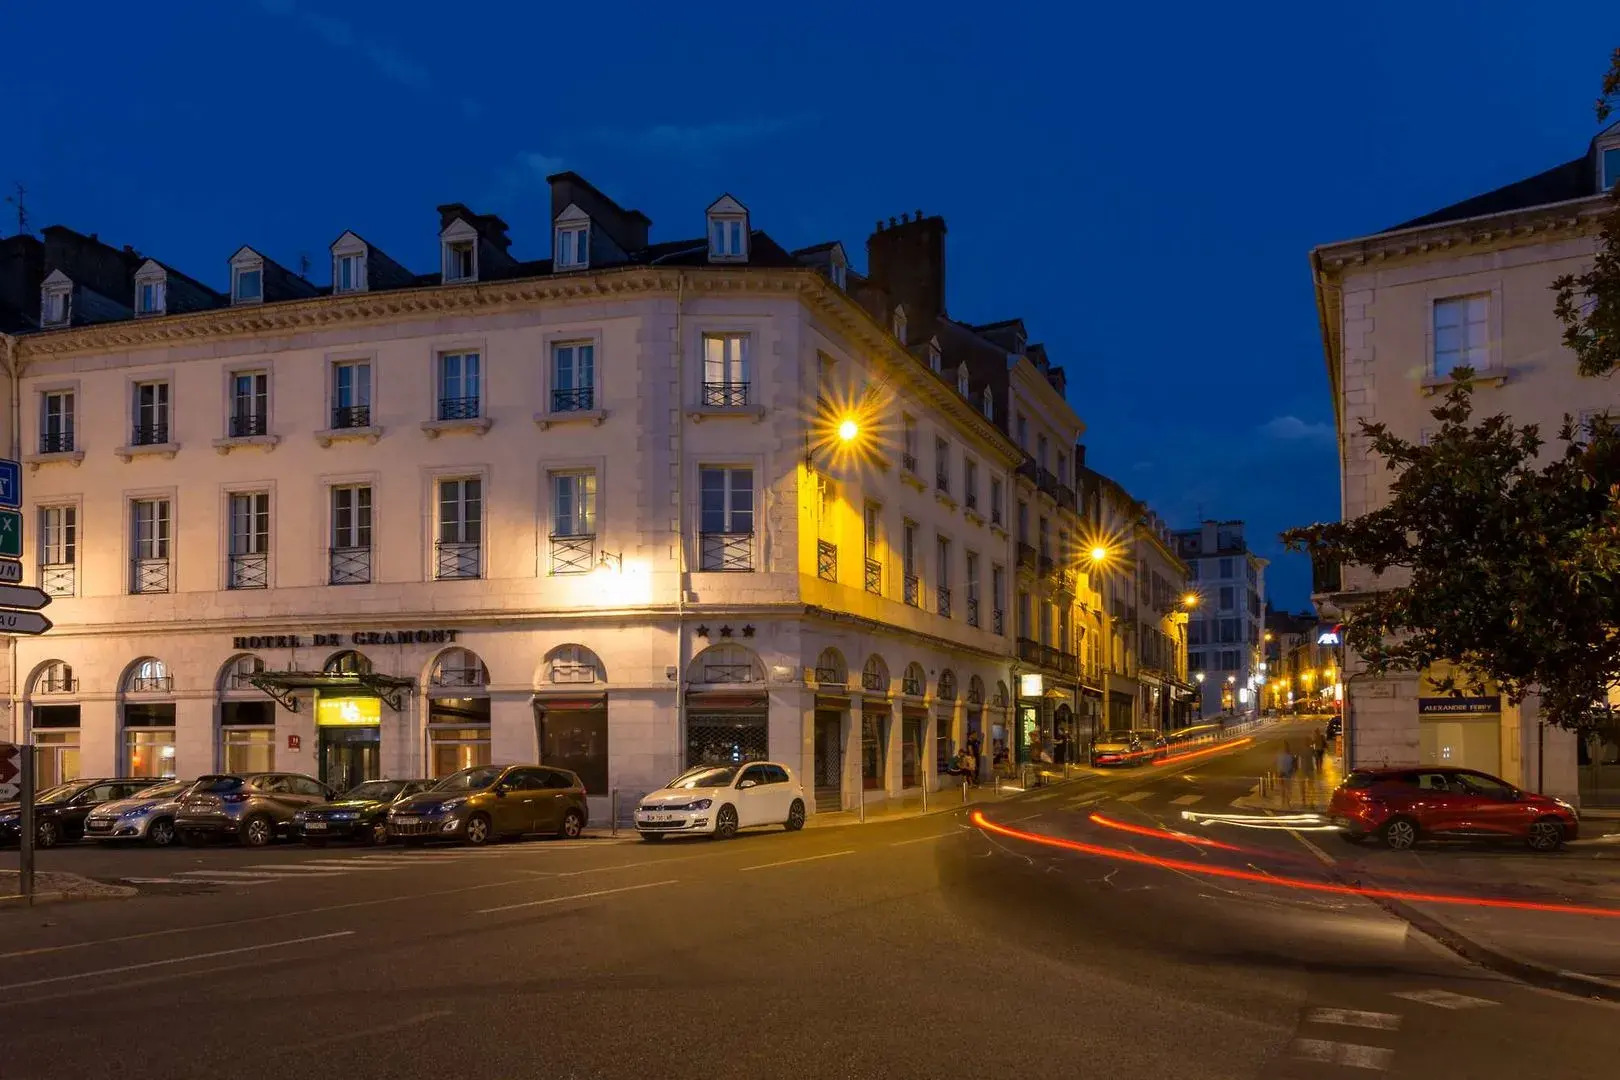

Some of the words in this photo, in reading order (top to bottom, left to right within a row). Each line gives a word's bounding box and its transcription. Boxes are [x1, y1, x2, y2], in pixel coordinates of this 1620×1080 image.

[233, 635, 303, 649] HOTEL
[313, 633, 340, 647] DE
[351, 629, 461, 645] GRAMONT
